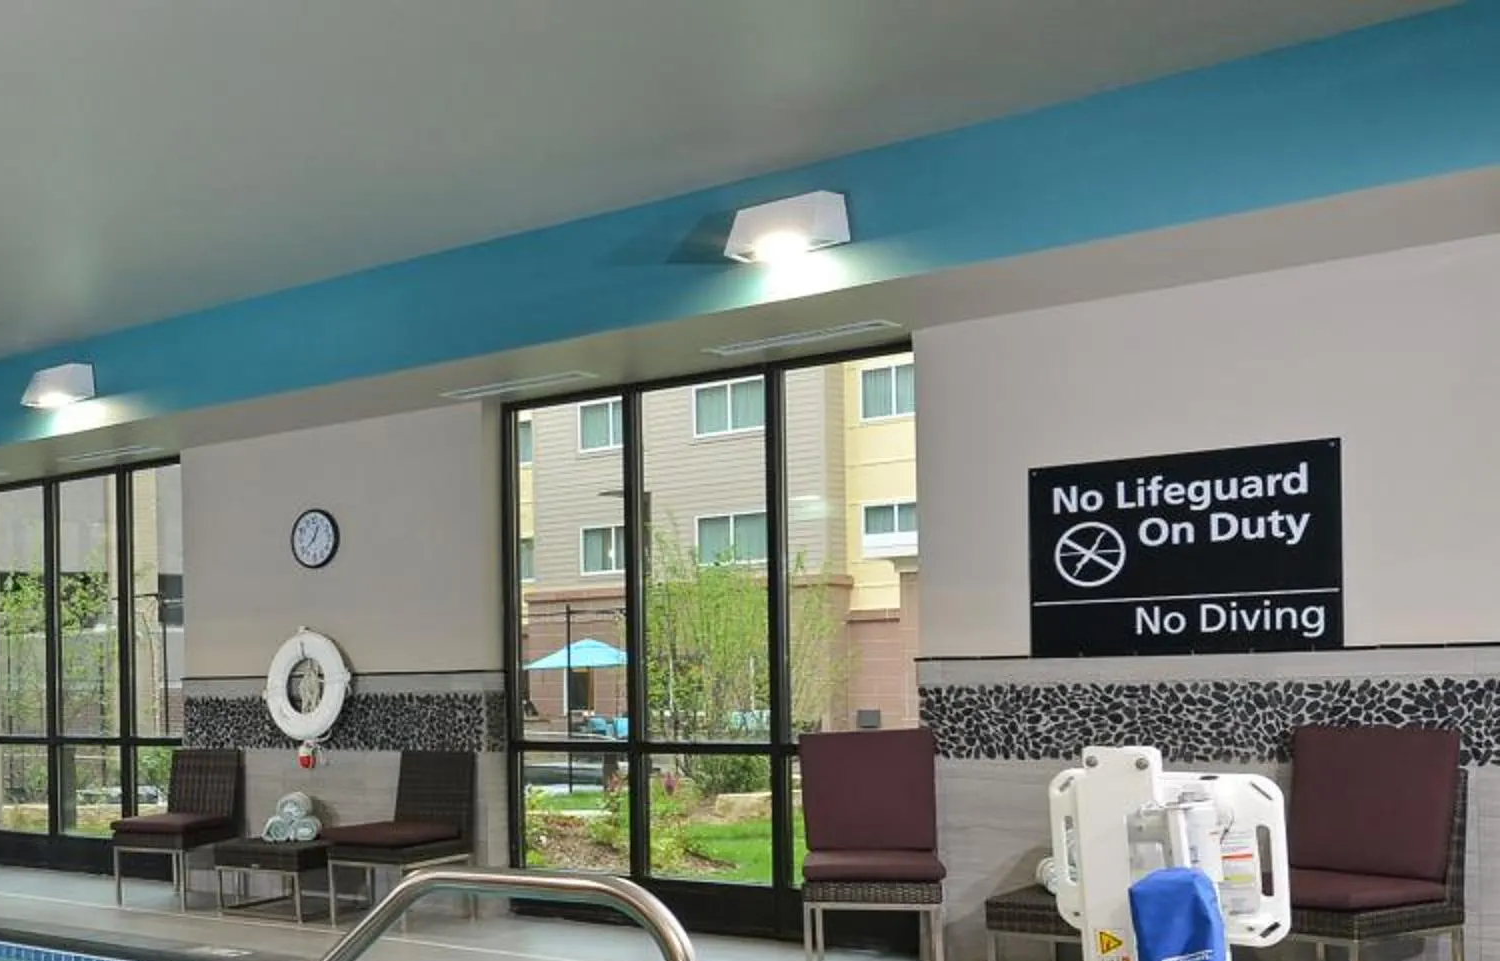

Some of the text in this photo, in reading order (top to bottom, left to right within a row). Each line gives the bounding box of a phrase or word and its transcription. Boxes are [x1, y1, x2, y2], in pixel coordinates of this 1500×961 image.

[1052, 461, 1309, 515] No Lifeguard
[1138, 510, 1311, 546] On Duty
[1135, 600, 1326, 637] No Diving
